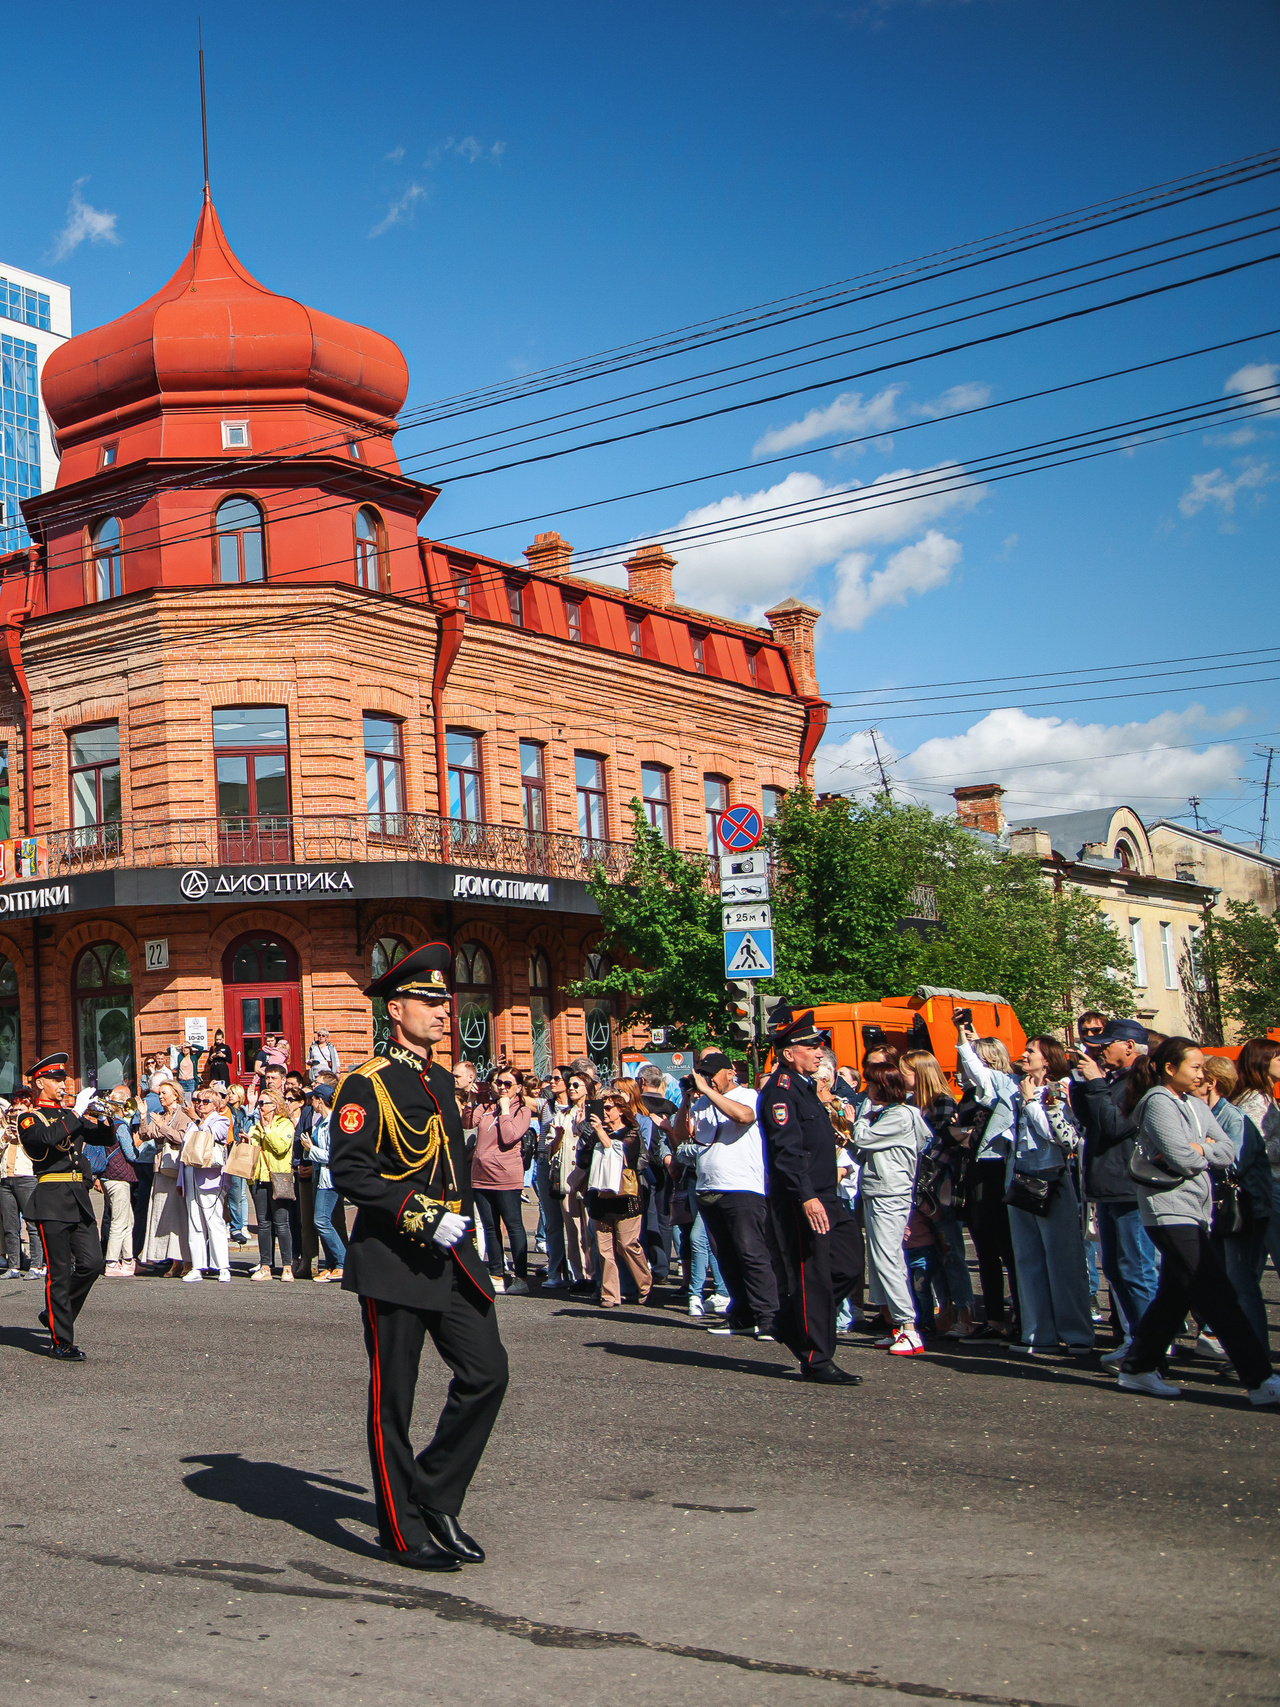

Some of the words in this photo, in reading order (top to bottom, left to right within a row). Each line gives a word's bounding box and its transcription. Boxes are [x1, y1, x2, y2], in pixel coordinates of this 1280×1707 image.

[214, 870, 355, 893] ДИОПТРИКА
[453, 874, 490, 898] ДОМ
[491, 878, 549, 902] ОПТИКИ
[149, 943, 163, 966] 22
